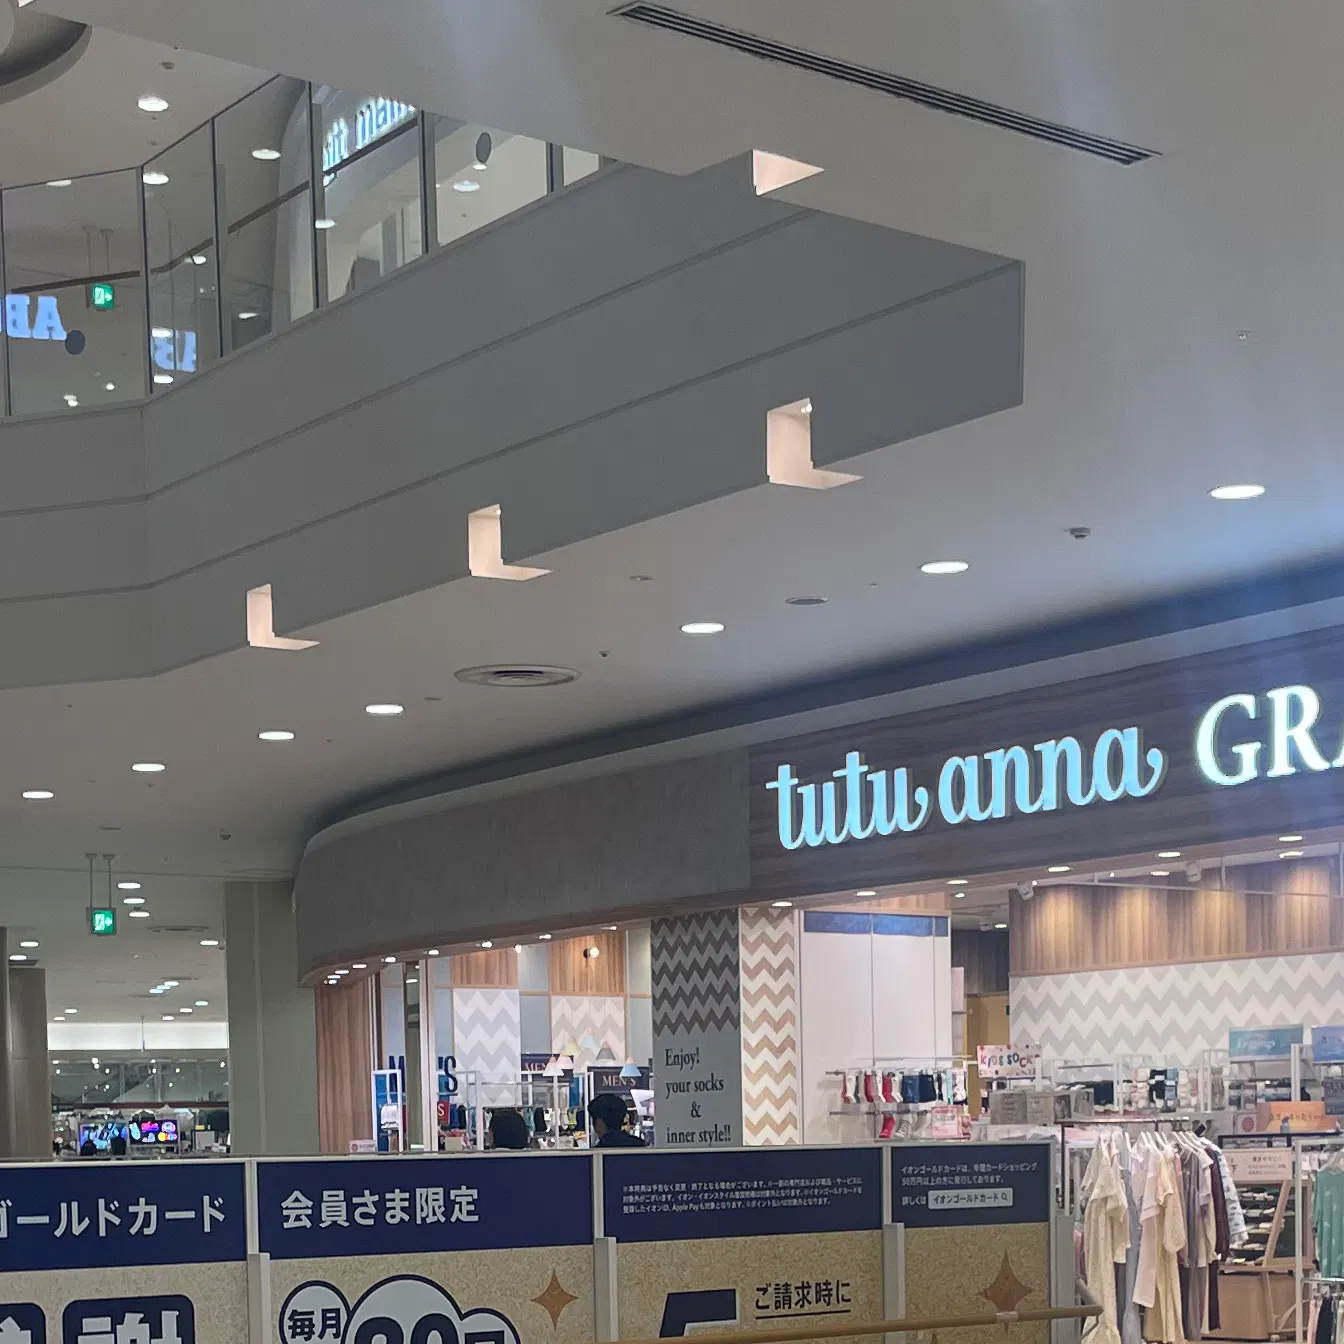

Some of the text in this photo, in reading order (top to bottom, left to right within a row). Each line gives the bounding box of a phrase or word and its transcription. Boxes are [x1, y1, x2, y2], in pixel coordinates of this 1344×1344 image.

[665, 1047, 700, 1071] Enjoy!
[1007, 1052, 1034, 1068] SOCK
[389, 1055, 458, 1094] M'S
[666, 1073, 724, 1099] your socks
[690, 1101, 702, 1118] &
[667, 1124, 732, 1147] inner style!!
[281, 1185, 480, 1229] 会員さま限定
[754, 1279, 852, 1311] ご請求時に
[287, 1308, 342, 1341] 毎月
